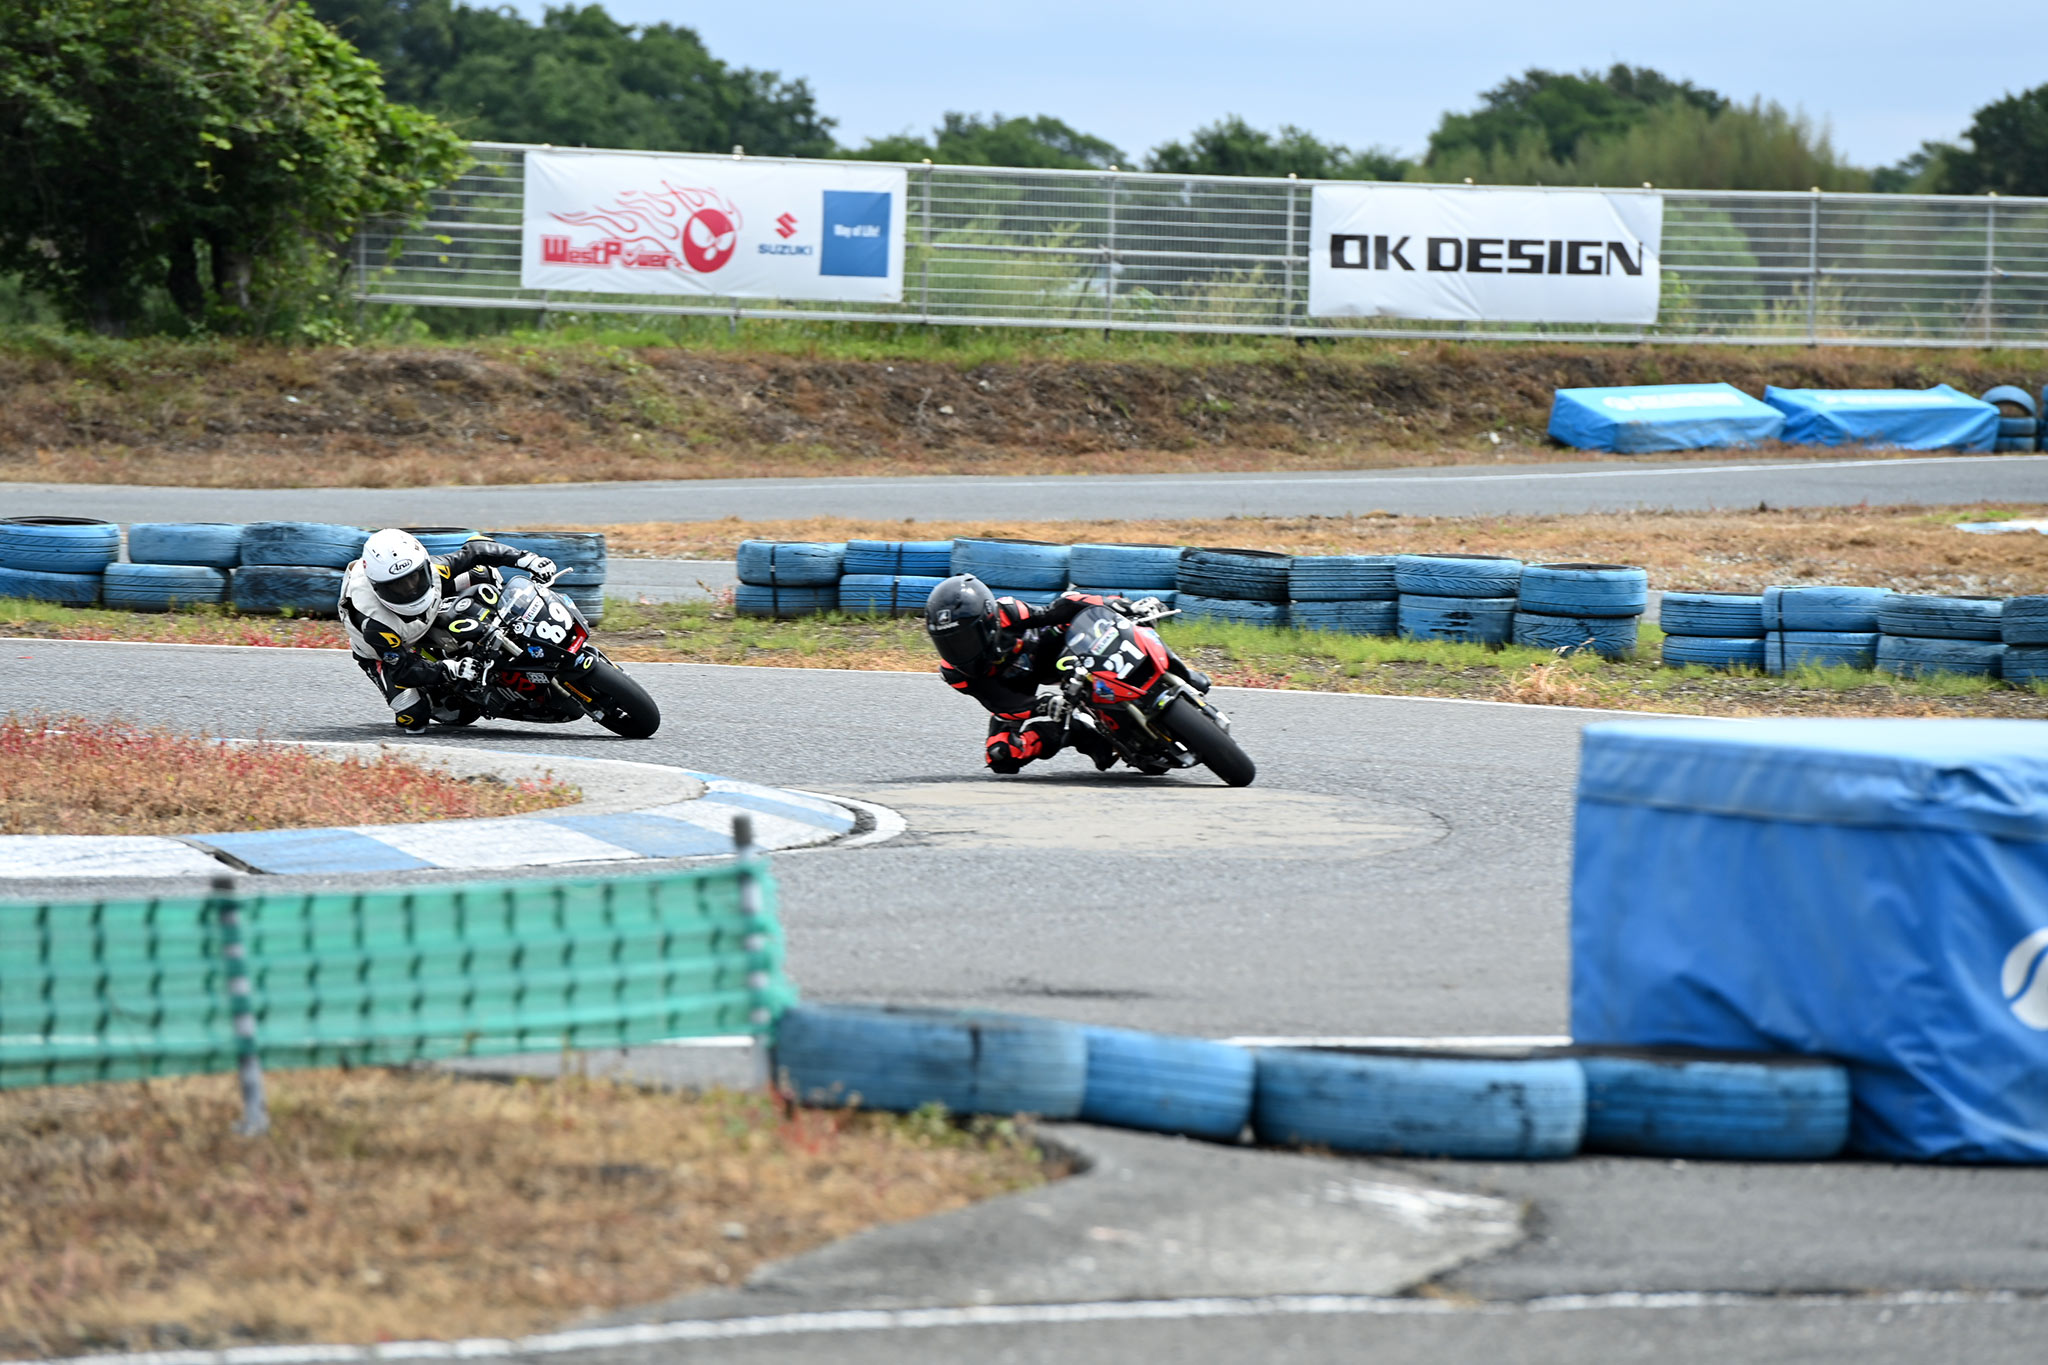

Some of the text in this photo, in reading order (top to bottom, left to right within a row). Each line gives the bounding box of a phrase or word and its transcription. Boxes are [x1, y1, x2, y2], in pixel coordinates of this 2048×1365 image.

[757, 244, 813, 255] SUZUKI
[1330, 234, 1643, 276] OK DESIGN
[390, 560, 411, 574] Arai
[535, 602, 573, 644] 89
[1103, 639, 1145, 680] 21
